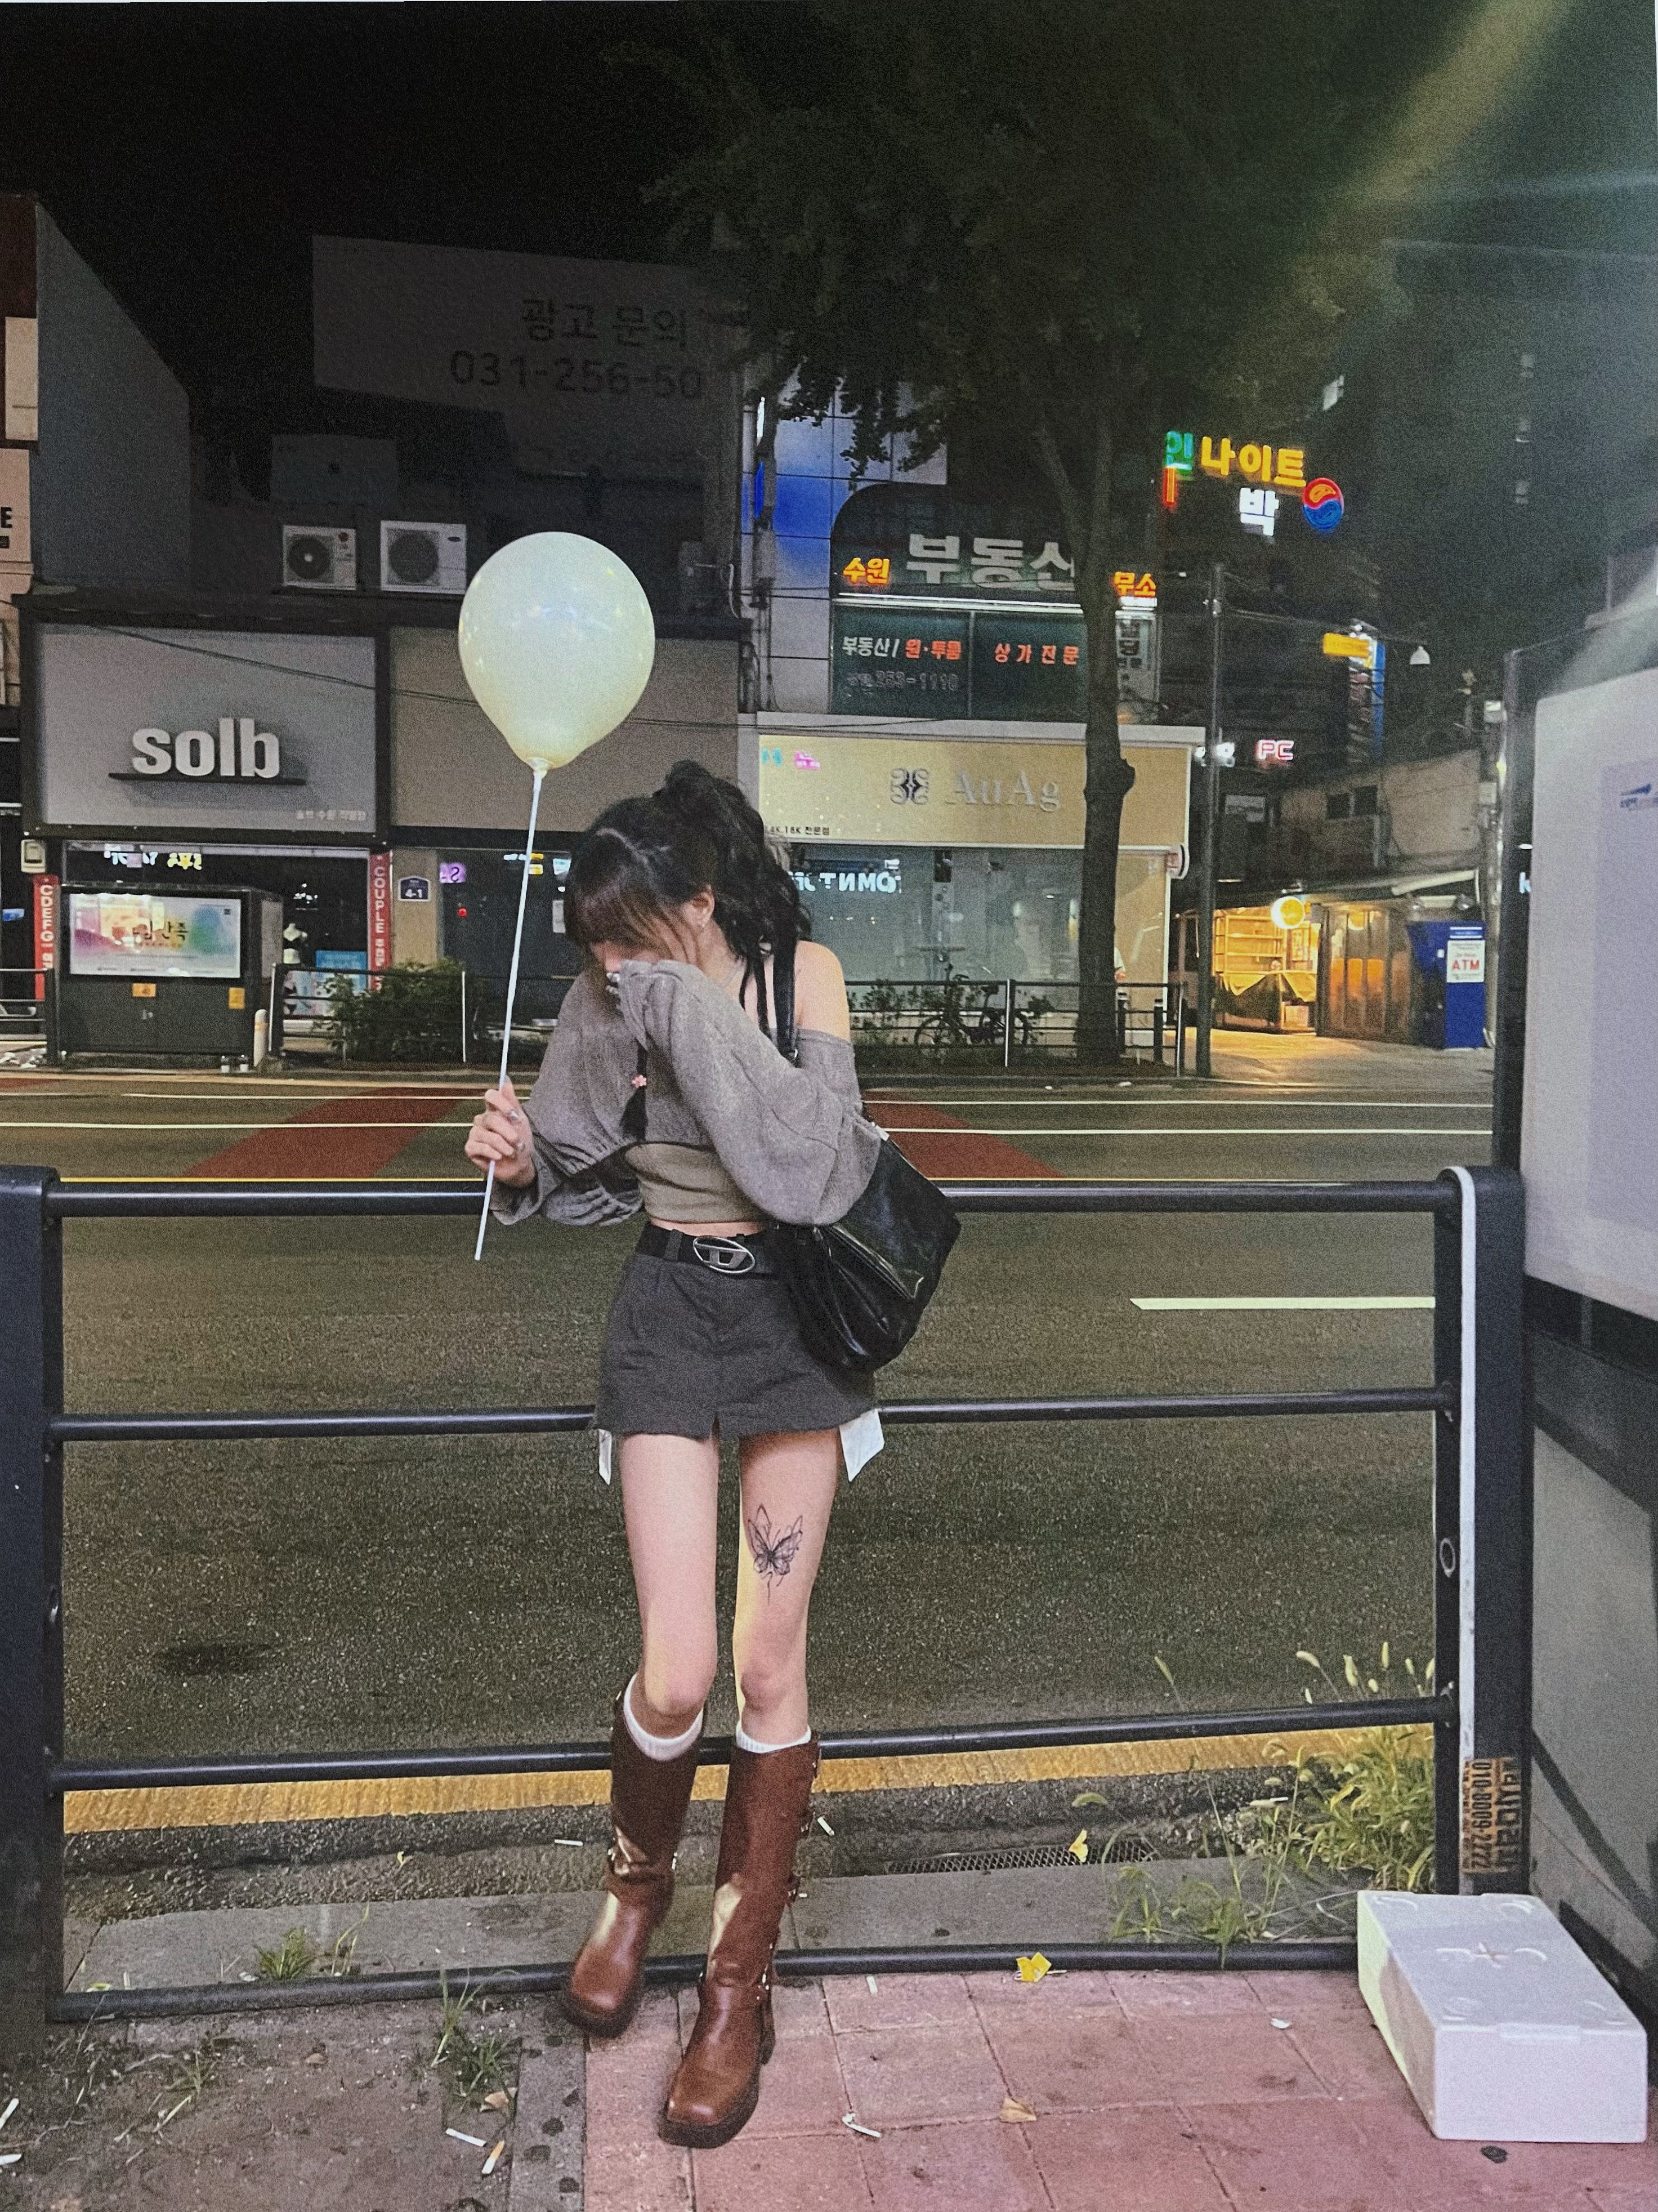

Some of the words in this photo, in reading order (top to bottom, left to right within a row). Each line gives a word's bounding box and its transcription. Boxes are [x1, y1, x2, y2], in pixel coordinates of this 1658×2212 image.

[522, 298, 597, 343] 광고
[611, 305, 687, 349] 문의
[1201, 435, 1306, 488] 나이트
[842, 556, 891, 586] 수원
[1113, 570, 1156, 597] 무소
[131, 717, 281, 779] solb
[1257, 739, 1295, 761] PC
[374, 867, 386, 934] COUPLE
[1452, 958, 1480, 970] ATM
